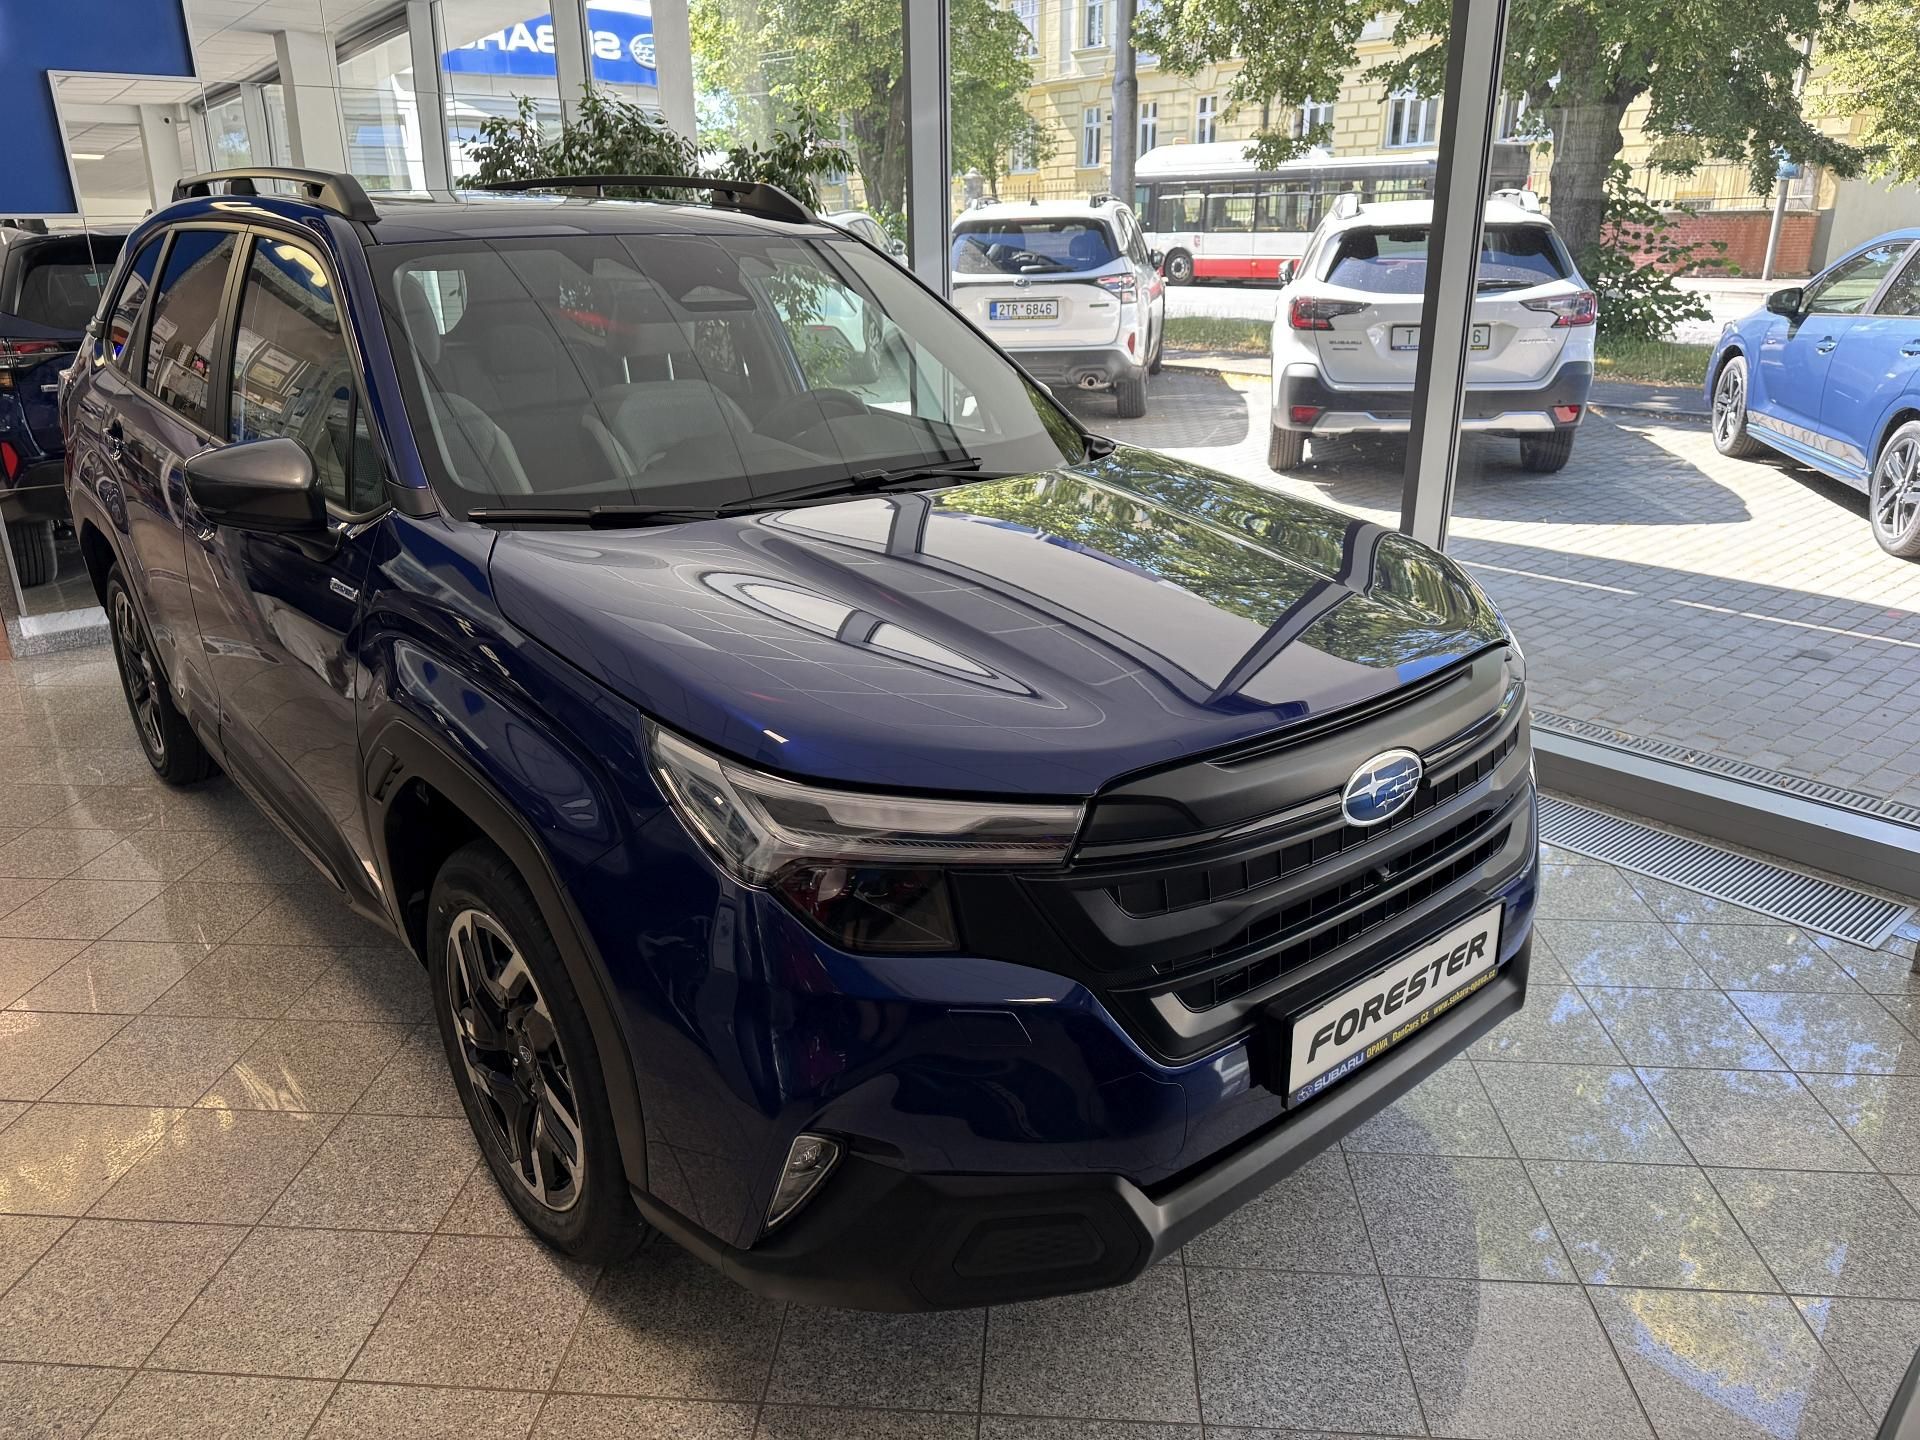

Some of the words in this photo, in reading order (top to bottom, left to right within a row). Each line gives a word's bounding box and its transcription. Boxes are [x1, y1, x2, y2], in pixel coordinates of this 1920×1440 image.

[1000, 304, 1018, 315] 2TR
[1026, 303, 1052, 315] 6846
[1307, 930, 1488, 1065] FORESTER
[1314, 1052, 1364, 1091] SUBARU
[1366, 1038, 1388, 1058] OPAVA
[1392, 1020, 1419, 1042] DanCars
[1420, 1012, 1429, 1024] CZ
